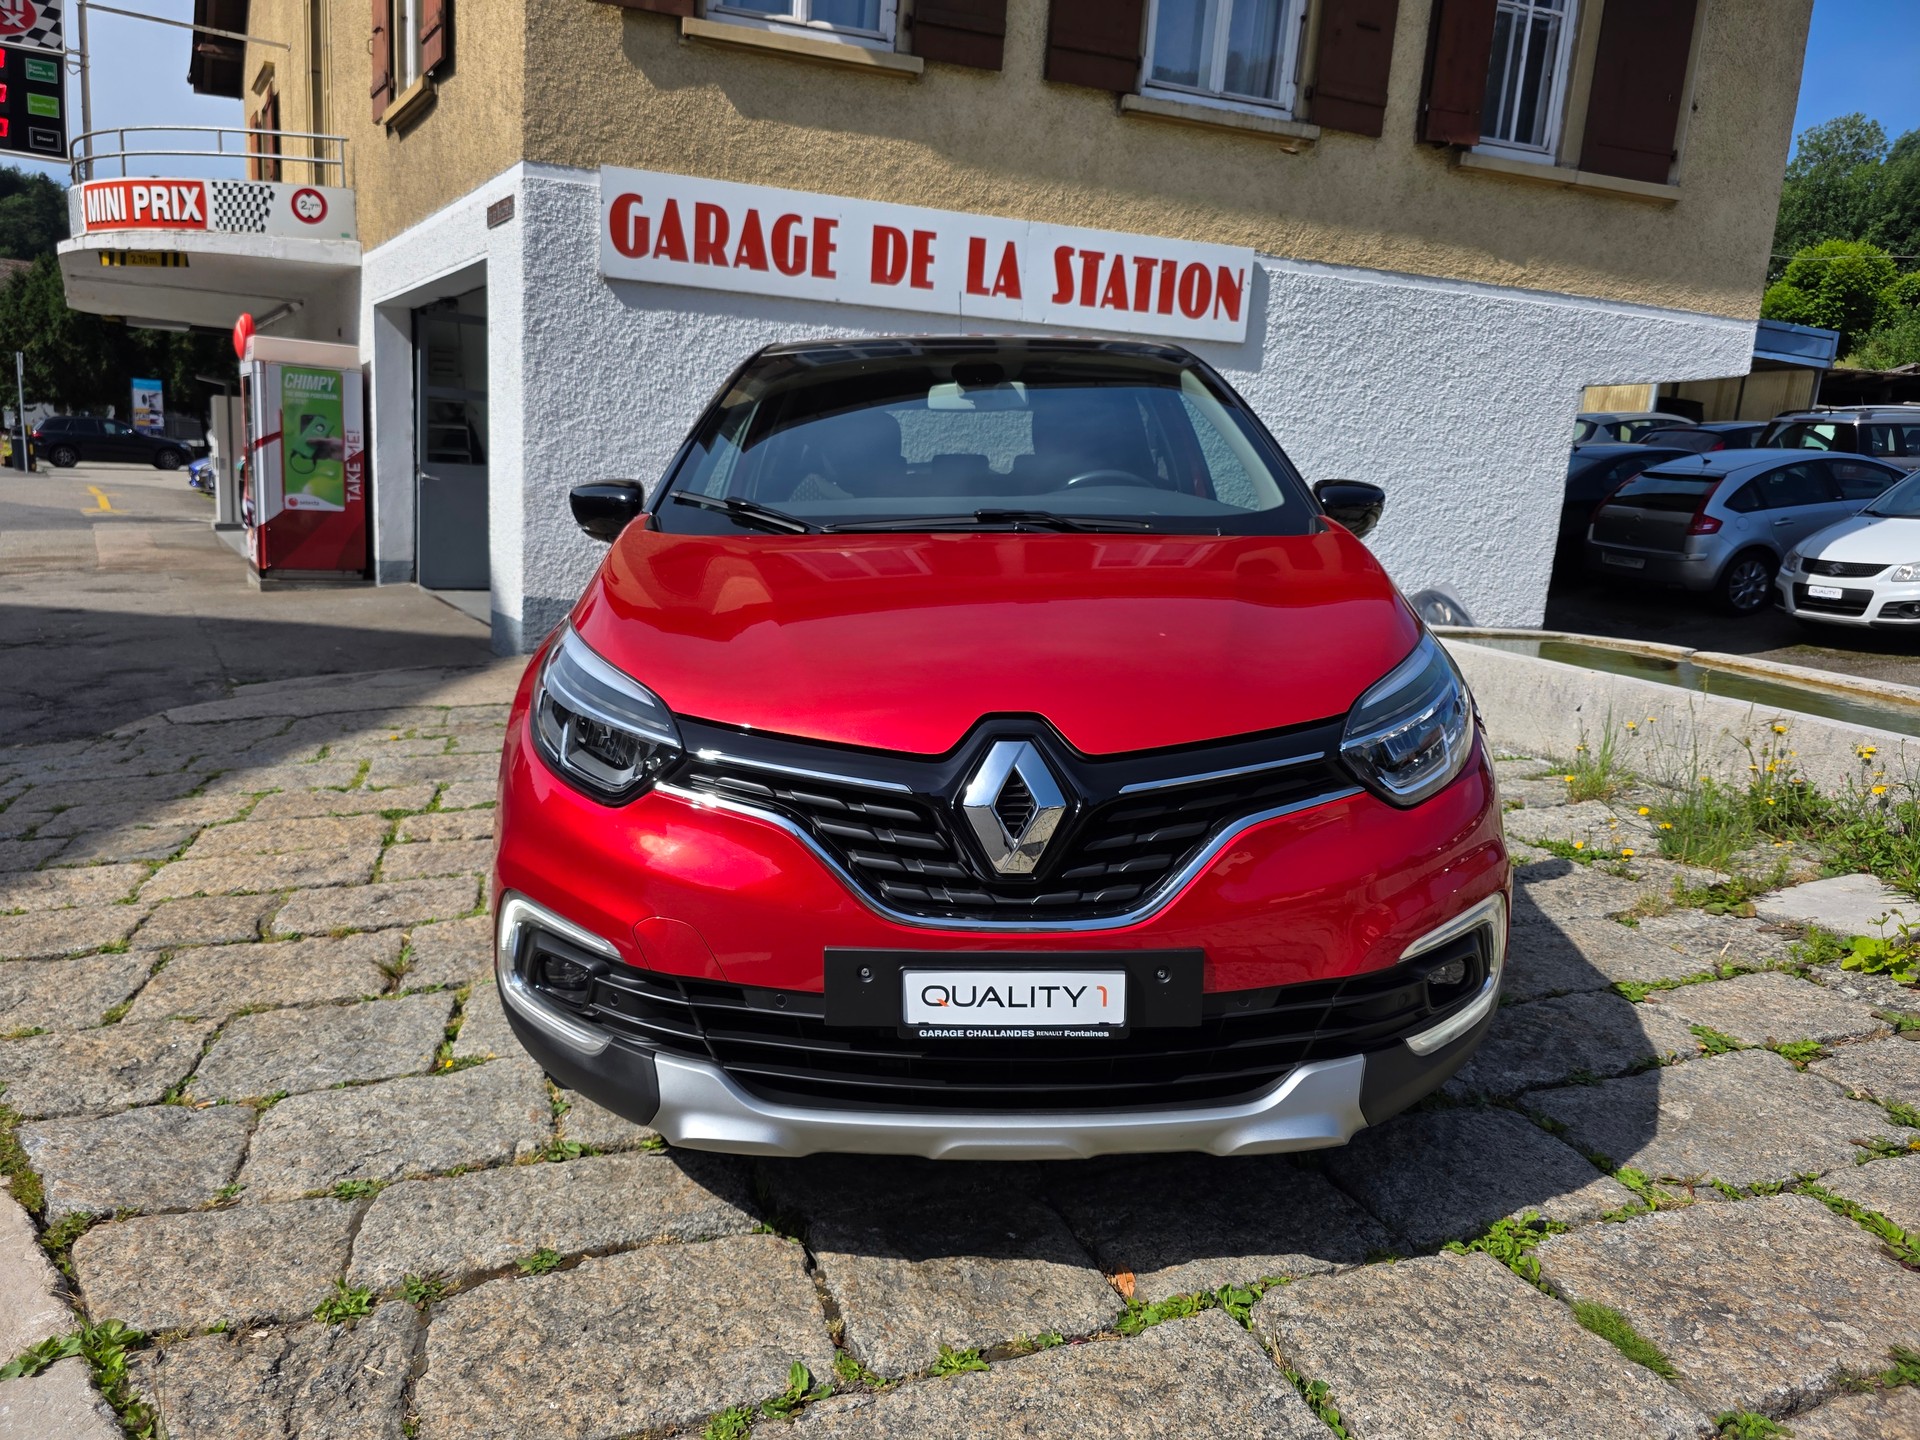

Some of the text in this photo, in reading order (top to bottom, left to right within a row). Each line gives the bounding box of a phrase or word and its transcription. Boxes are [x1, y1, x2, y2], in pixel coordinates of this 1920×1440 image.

[36, 135, 54, 143] Diesel
[86, 185, 203, 223] MINI PRIX
[609, 193, 1244, 322] GARAGE DE LA STATION
[285, 373, 336, 392] CHIMPY
[346, 430, 362, 502] TAKE ME!
[1811, 588, 1836, 596] QUALITY
[921, 985, 1108, 1008] QUALITY 1
[918, 1029, 965, 1038] GARAGE
[966, 1029, 1035, 1038] CHALLANDES
[1064, 1029, 1110, 1038] Fontaines
